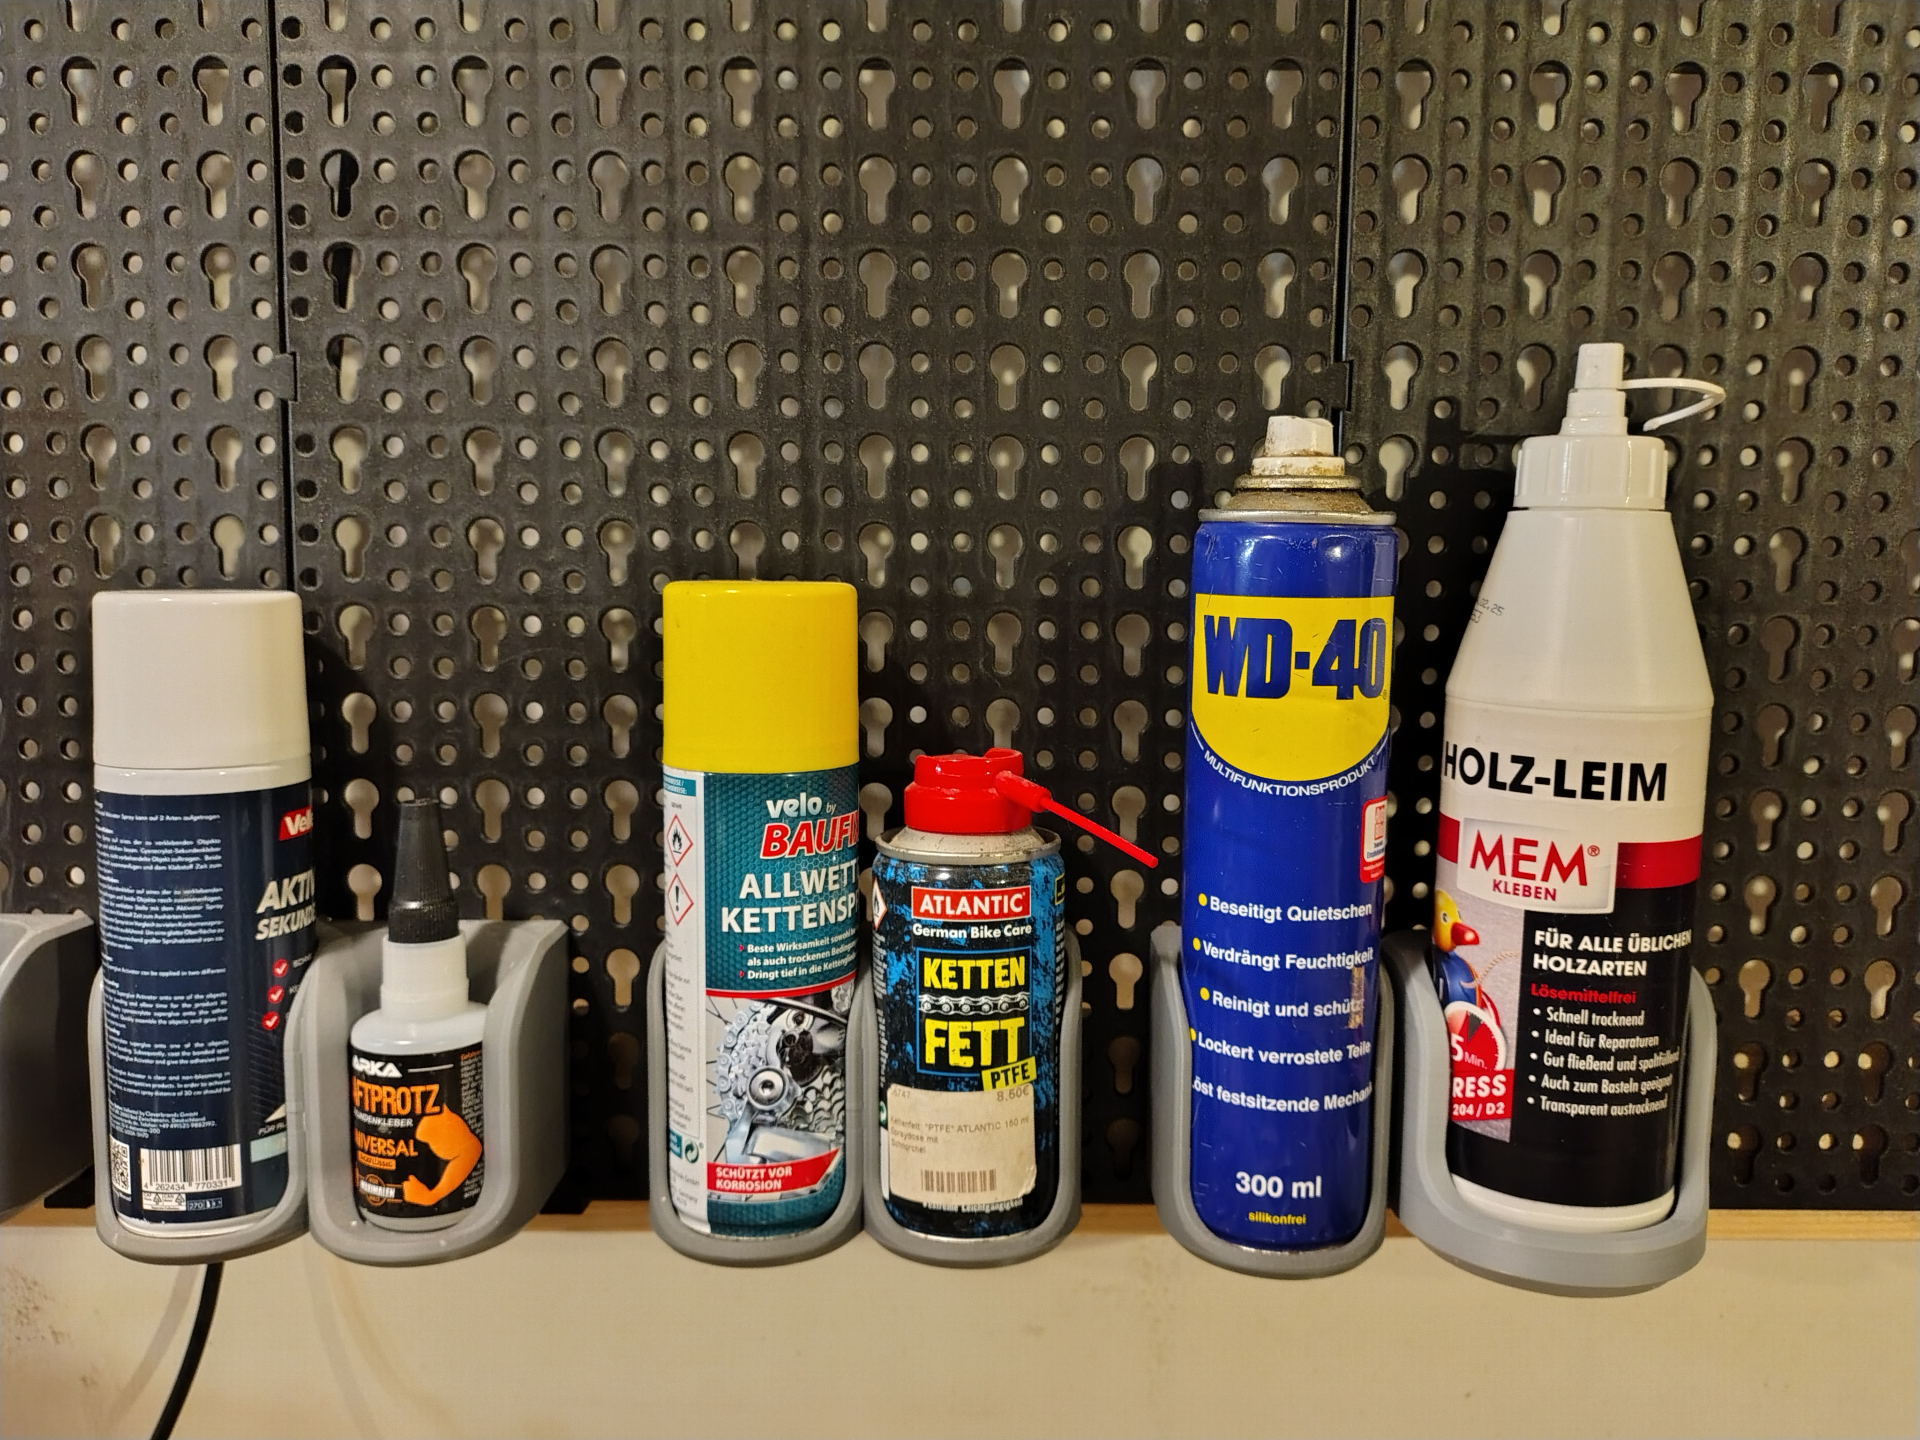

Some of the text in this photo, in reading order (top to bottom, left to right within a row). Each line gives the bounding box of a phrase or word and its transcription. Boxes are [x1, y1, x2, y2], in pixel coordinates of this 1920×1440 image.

[1204, 615, 1386, 700] WD-40
[1204, 750, 1377, 797] MULTIFUNKTIONSPRODUKT
[1444, 741, 1667, 802] HOLZ-LEIM
[766, 792, 837, 819] velo by
[739, 857, 858, 899] ALLWETT
[1493, 879, 1557, 902] KLEBEN
[1210, 896, 1373, 924] Beseitigt Quietschen
[912, 923, 1033, 939] German Bike Care
[1534, 927, 1693, 953] FÜR ALLE ÜBLICHEN
[747, 944, 775, 954] Beste
[776, 936, 830, 952] Wirksamkeit
[1202, 940, 1374, 972] Verdrängt Feuchtigkeit
[747, 957, 762, 967] als
[763, 955, 787, 966] auch
[788, 950, 831, 964] trockenen
[1532, 953, 1648, 977] HOLZARTEN
[747, 968, 780, 981] Dringt
[780, 967, 797, 977] tief
[798, 966, 808, 976] in
[809, 962, 823, 974] die
[923, 956, 1026, 990] KETTEN
[1212, 990, 1271, 1018] Reinigt
[1275, 1002, 1309, 1017] und
[1530, 982, 1637, 1004] Lösemittelfrei
[1546, 1006, 1646, 1027] Schnell trocknend
[924, 1016, 1025, 1068] FETT
[1198, 1031, 1372, 1066] Lockert verrostete Teile
[1545, 1028, 1660, 1053] Ideal für Reparaturen
[1464, 1051, 1488, 1071] Min.
[1543, 1050, 1565, 1068] Gut
[1567, 1052, 1615, 1072] fließend
[1617, 1055, 1638, 1072] und
[990, 1061, 1031, 1090] PTFE
[1540, 1073, 1673, 1096] Auch zum Basteln geeignet
[352, 1076, 442, 1116] FTPROTZ
[1216, 1085, 1320, 1113] festsitzende
[1486, 1101, 1505, 1116] D2
[1540, 1092, 1669, 1118] Transparent austrocknend
[956, 1121, 1002, 1134] ATLANTIC
[155, 1183, 186, 1191] 262434
[195, 1179, 229, 1190] 770331
[715, 1165, 793, 1180] SCHÜTZT VOR
[715, 1178, 782, 1192] KORROSION
[1235, 1171, 1323, 1199] 300 ml
[1248, 1210, 1307, 1225] silikonfrei
